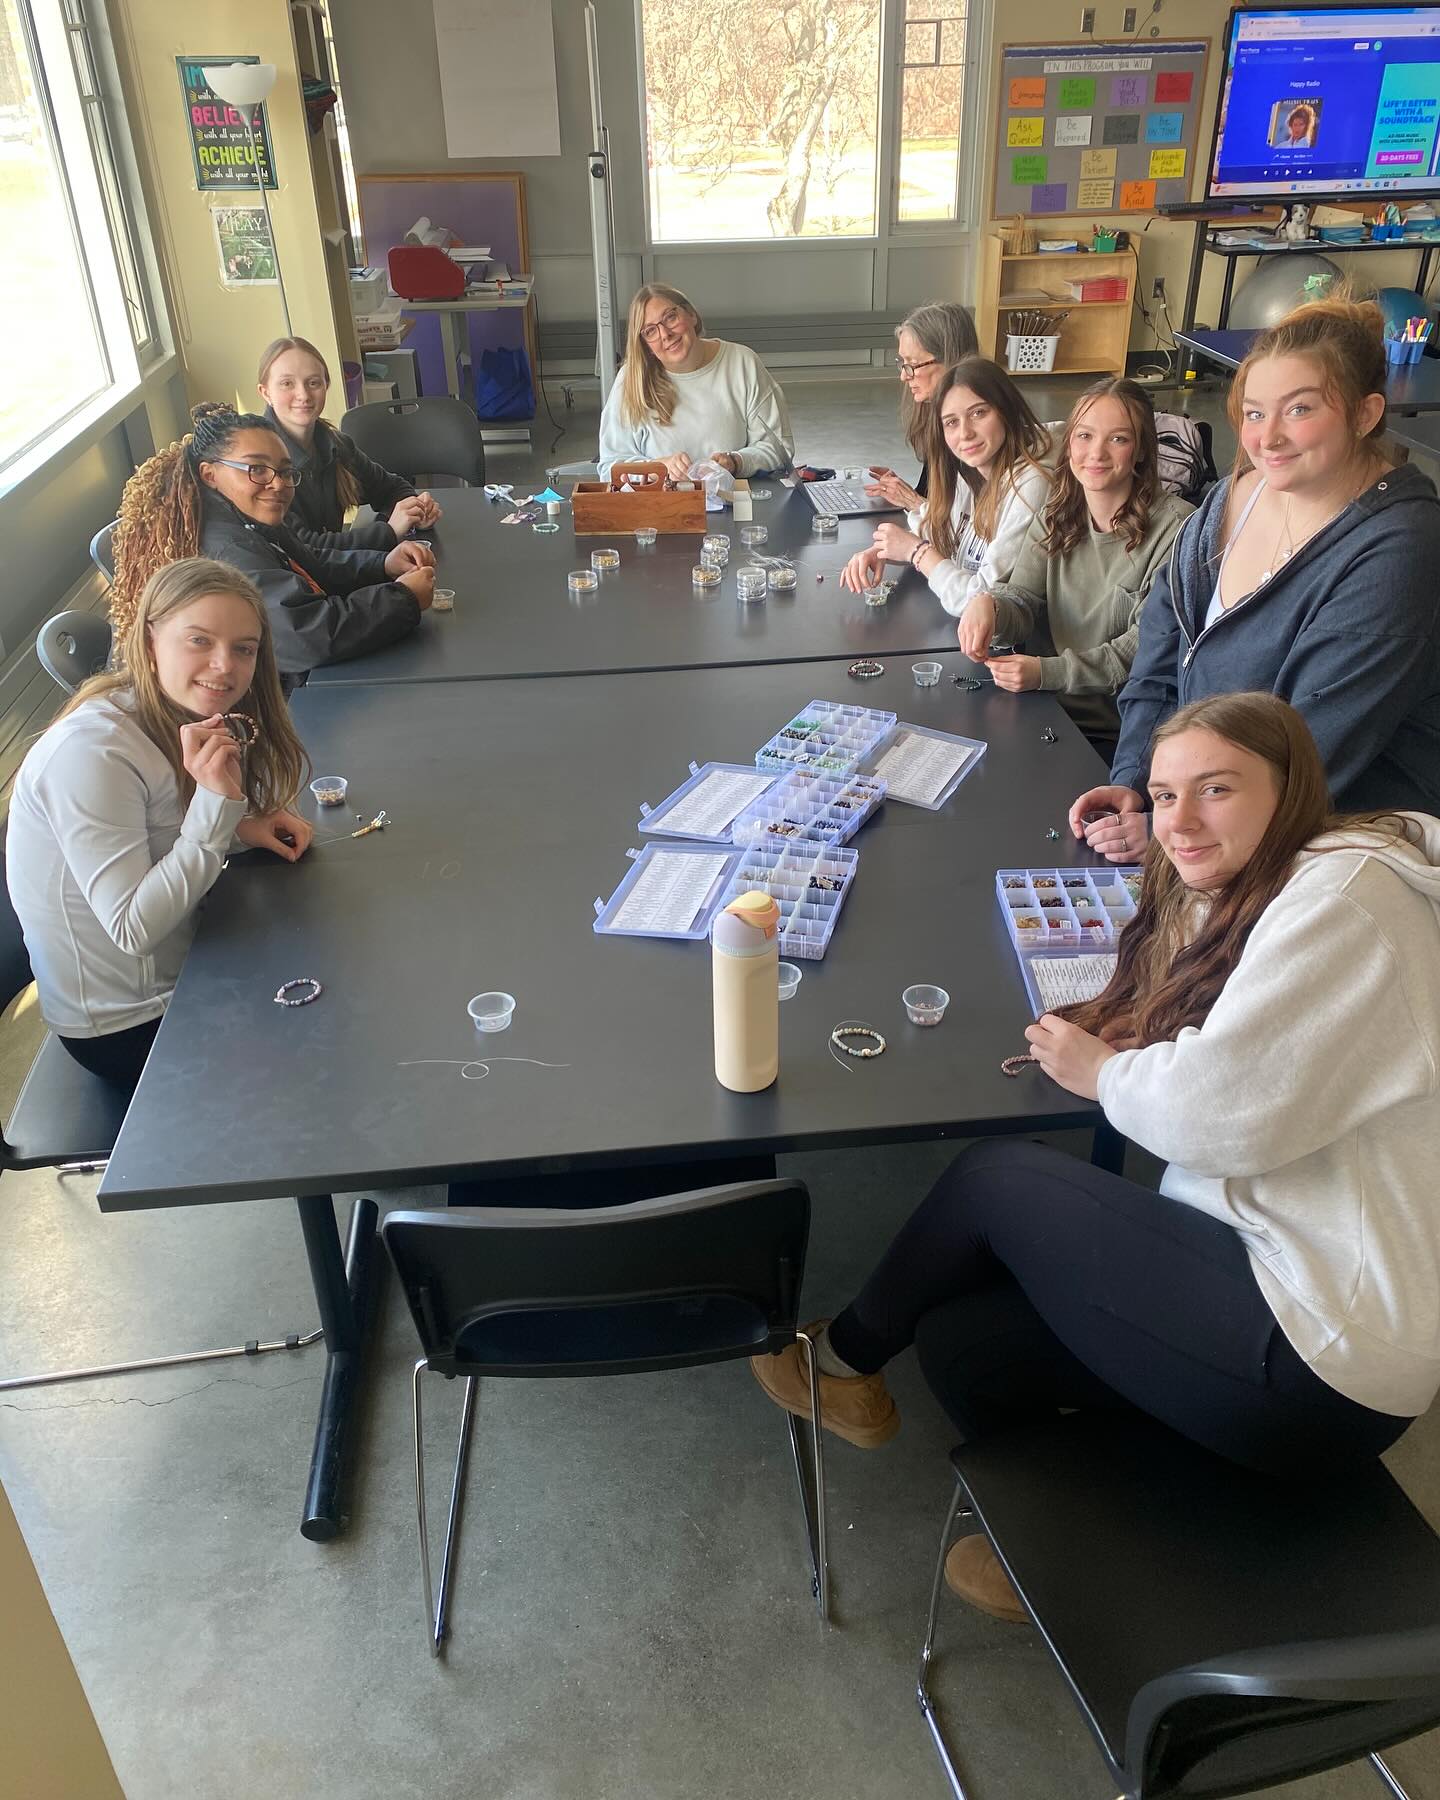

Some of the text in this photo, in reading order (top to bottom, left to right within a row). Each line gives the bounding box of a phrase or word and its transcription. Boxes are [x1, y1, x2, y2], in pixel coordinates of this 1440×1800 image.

[1289, 81, 1306, 89] Happy
[1407, 99, 1437, 107] BETTER
[1379, 116, 1435, 125] SOUNDTRACK
[204, 128, 218, 139] with
[219, 128, 228, 139] all
[229, 133, 243, 142] your
[199, 145, 267, 166] ACHIEVE
[210, 168, 223, 178] with
[225, 167, 234, 178] all
[235, 173, 249, 181] your
